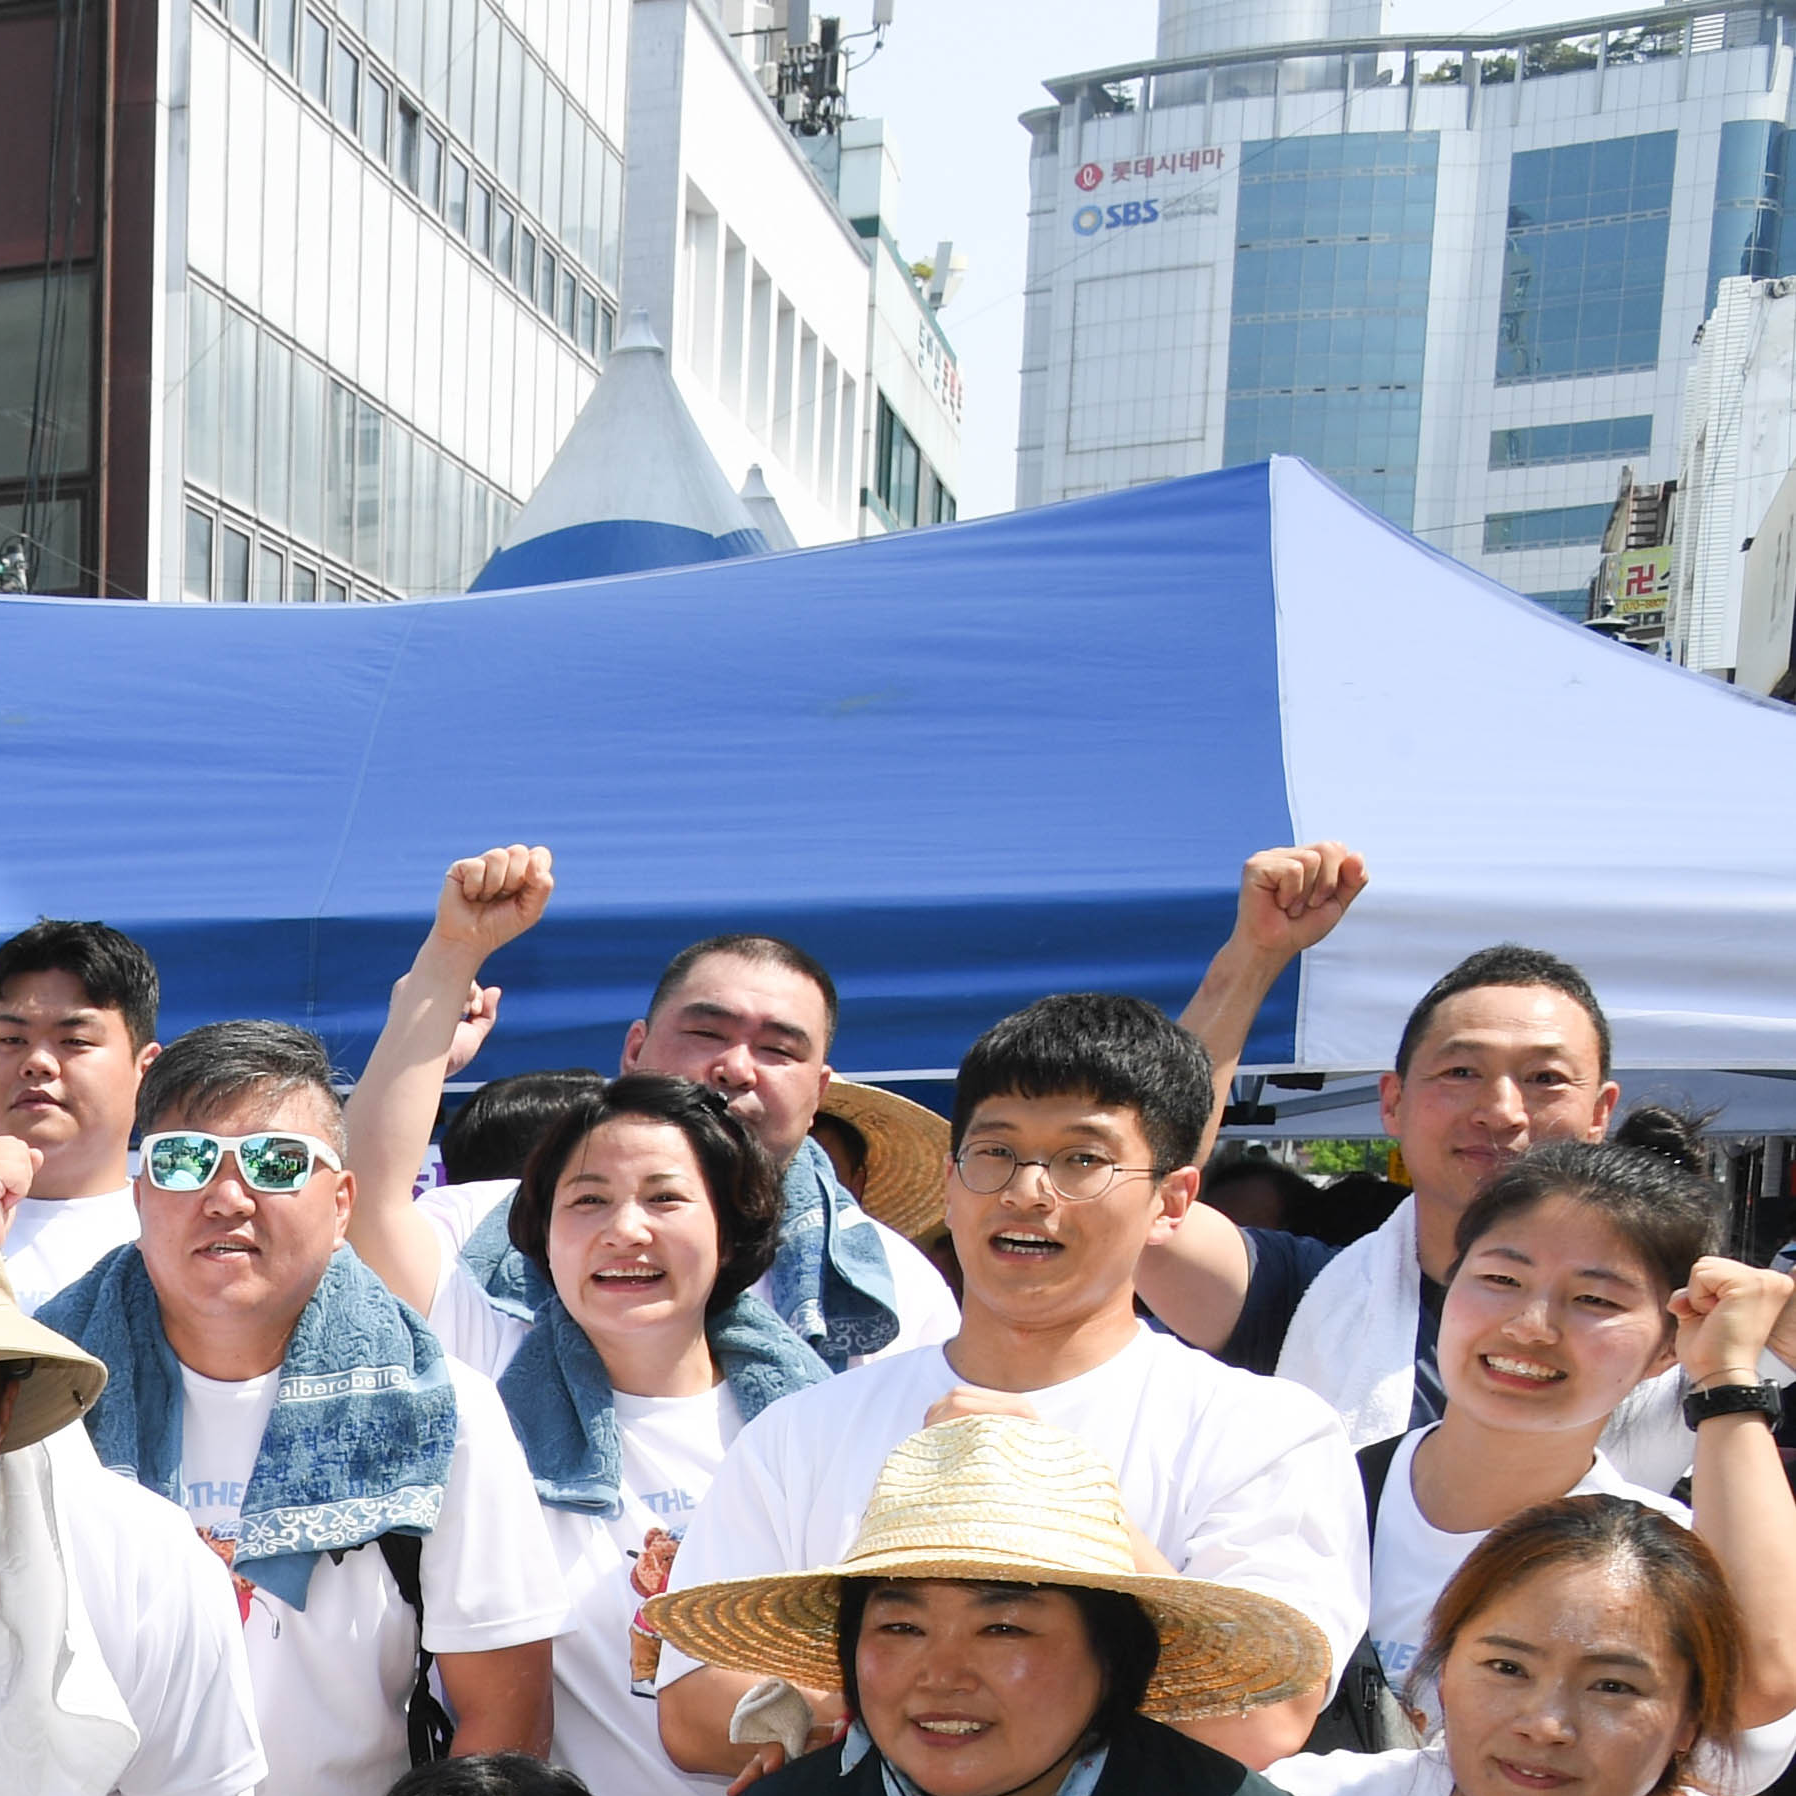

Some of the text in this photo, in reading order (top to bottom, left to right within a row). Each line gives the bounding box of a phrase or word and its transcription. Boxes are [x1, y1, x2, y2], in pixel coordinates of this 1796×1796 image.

[1111, 148, 1225, 184] 롯데시네마
[1105, 199, 1160, 229] SBS
[279, 1372, 403, 1398] alberobello
[188, 1481, 241, 1508] THE
[640, 1488, 694, 1513] THE
